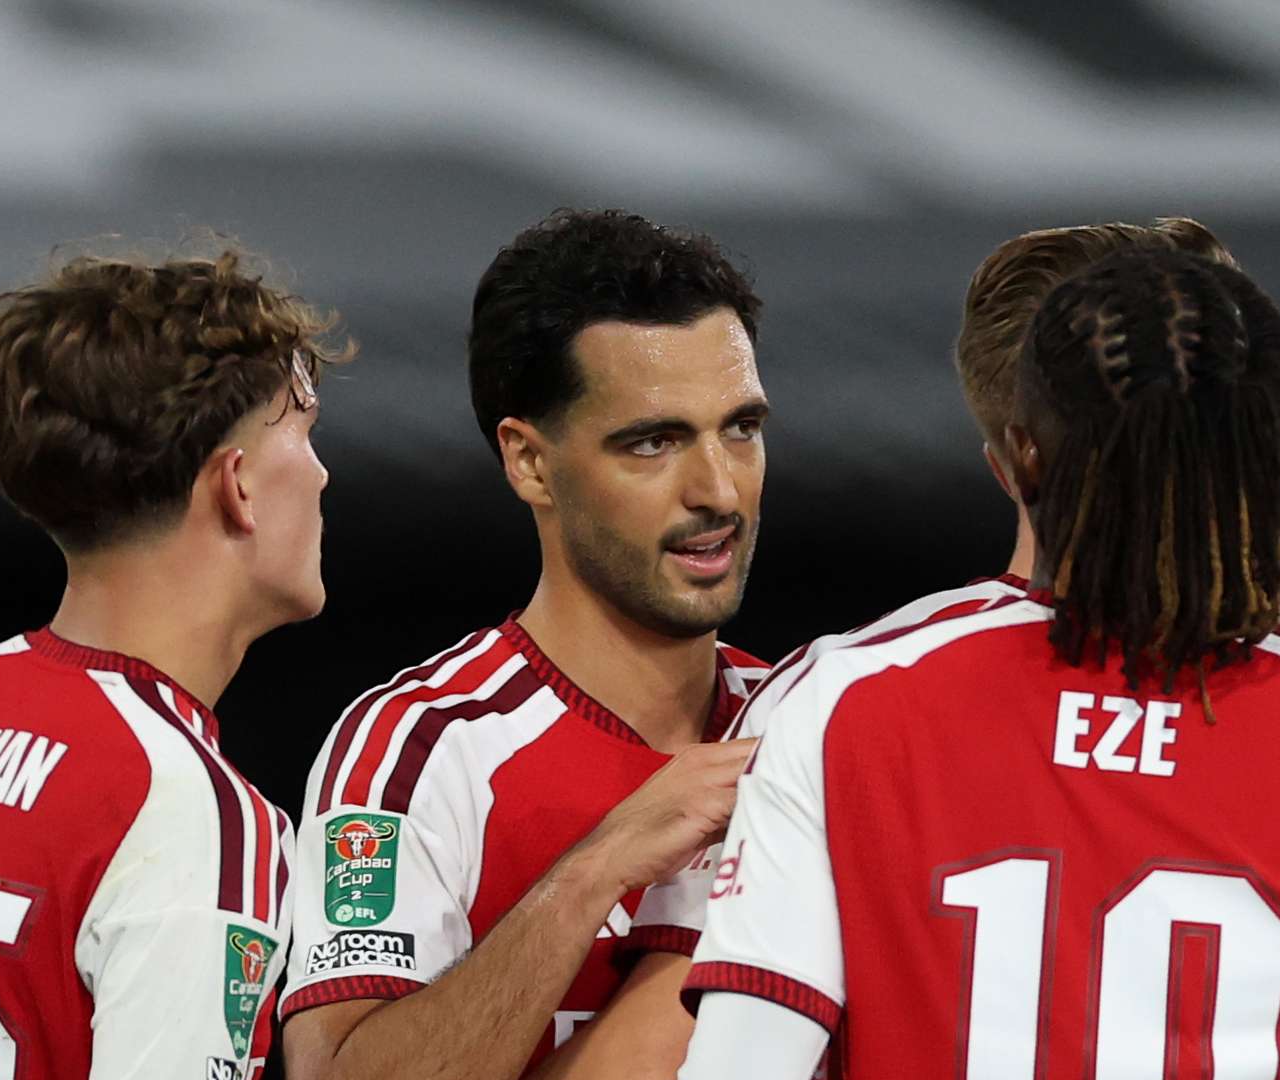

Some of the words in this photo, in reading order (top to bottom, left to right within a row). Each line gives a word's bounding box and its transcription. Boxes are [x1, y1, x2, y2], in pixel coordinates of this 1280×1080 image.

[1053, 690, 1182, 777] EZE
[327, 855, 392, 884] Carabao
[339, 872, 373, 889] Cup
[351, 890, 362, 900] 2
[355, 907, 377, 920] EFL
[310, 941, 339, 961] No
[340, 933, 405, 952] room
[340, 950, 415, 971] racism
